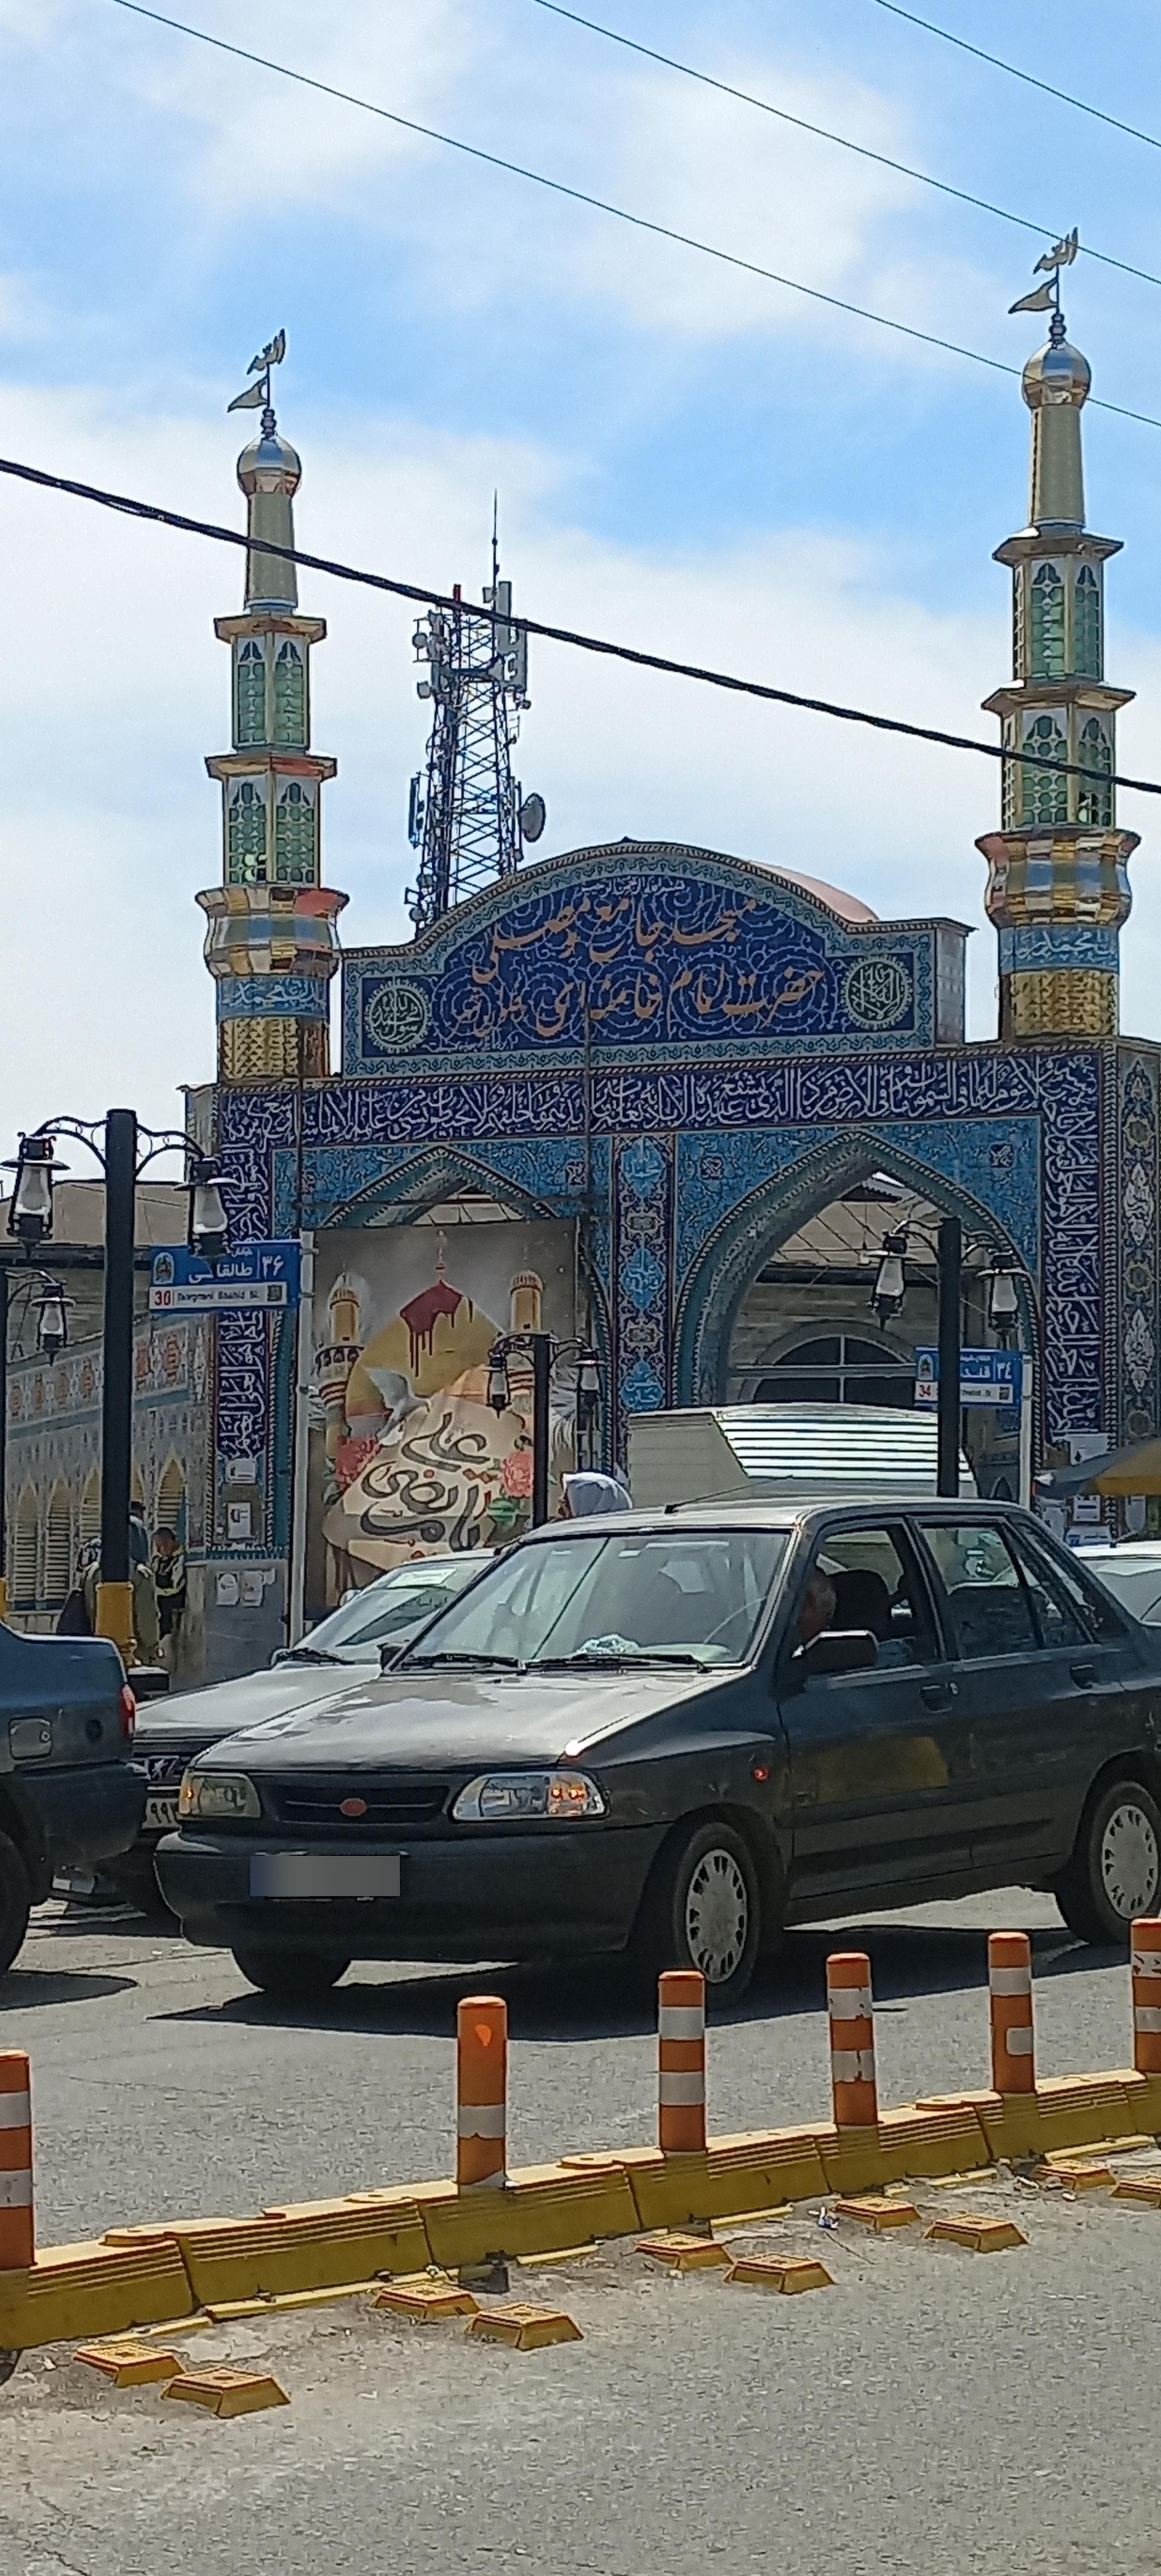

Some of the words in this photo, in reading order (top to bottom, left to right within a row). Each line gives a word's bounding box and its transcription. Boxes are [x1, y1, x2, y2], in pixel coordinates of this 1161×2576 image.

[471, 897, 590, 984] مصلی
[588, 897, 664, 961] جامع
[668, 899, 757, 946] مسجد
[666, 964, 726, 1040] امام
[723, 966, 825, 1029] حضرت
[262, 1255, 284, 1280] ۳۶
